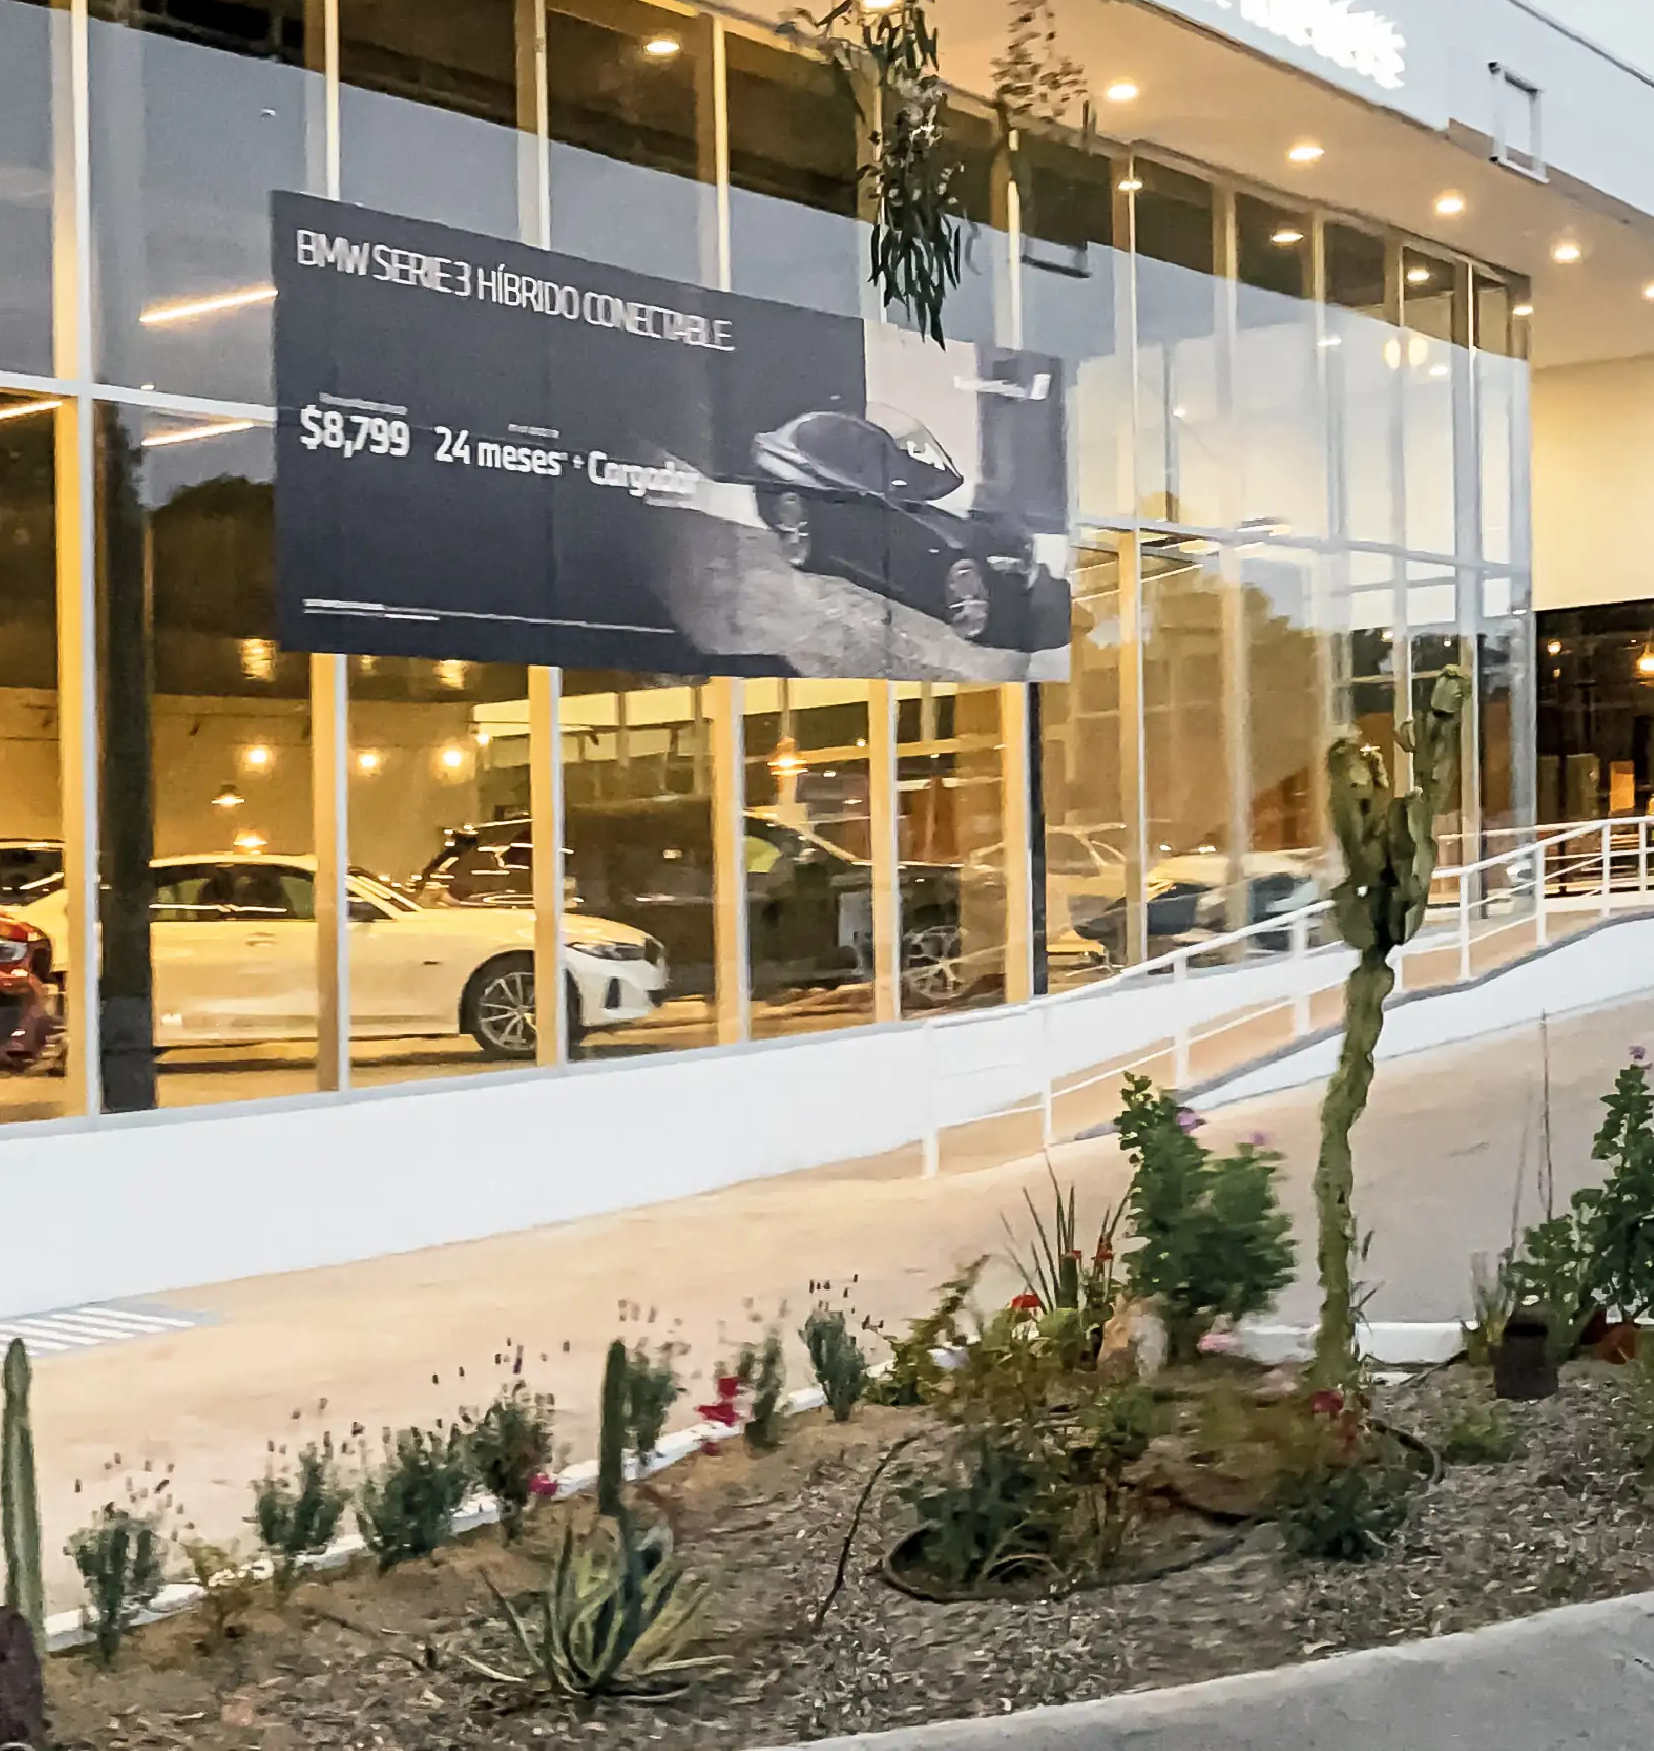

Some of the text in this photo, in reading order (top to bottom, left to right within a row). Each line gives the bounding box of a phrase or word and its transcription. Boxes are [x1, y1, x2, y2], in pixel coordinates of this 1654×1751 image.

[296, 229, 371, 276] BMW
[476, 263, 579, 320] HÍBRIDO
[300, 404, 410, 458] $8,799
[434, 425, 470, 466] 24
